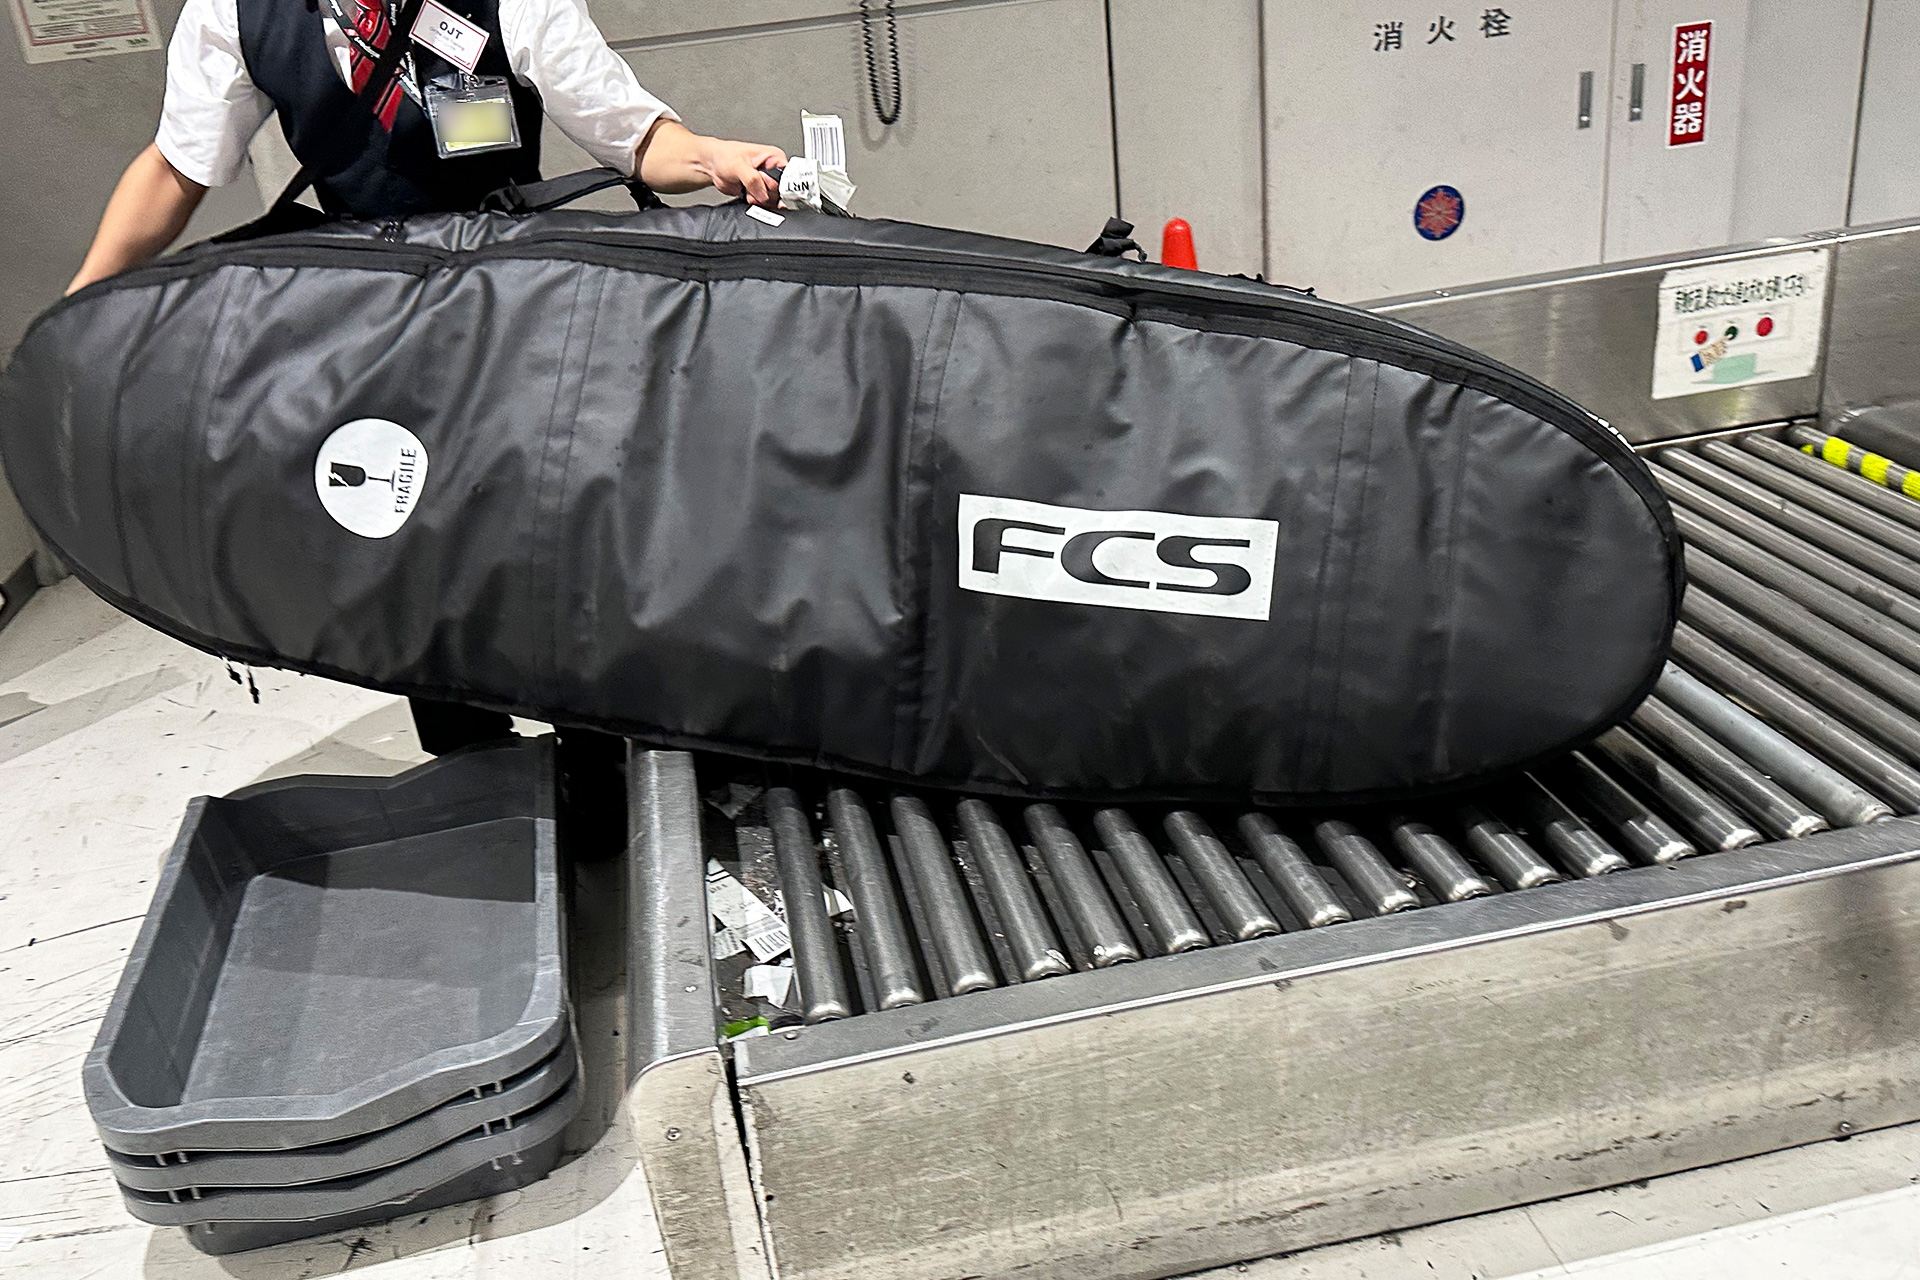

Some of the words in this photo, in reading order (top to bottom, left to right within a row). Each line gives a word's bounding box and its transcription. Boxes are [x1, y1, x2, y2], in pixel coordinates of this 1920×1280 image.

[440, 21, 463, 39] OJT
[1373, 8, 1511, 51] 消火栓
[1673, 29, 1708, 135] 消火器
[787, 181, 809, 191] NRT
[394, 448, 418, 514] FRAGILE
[972, 518, 1251, 596] FCS
